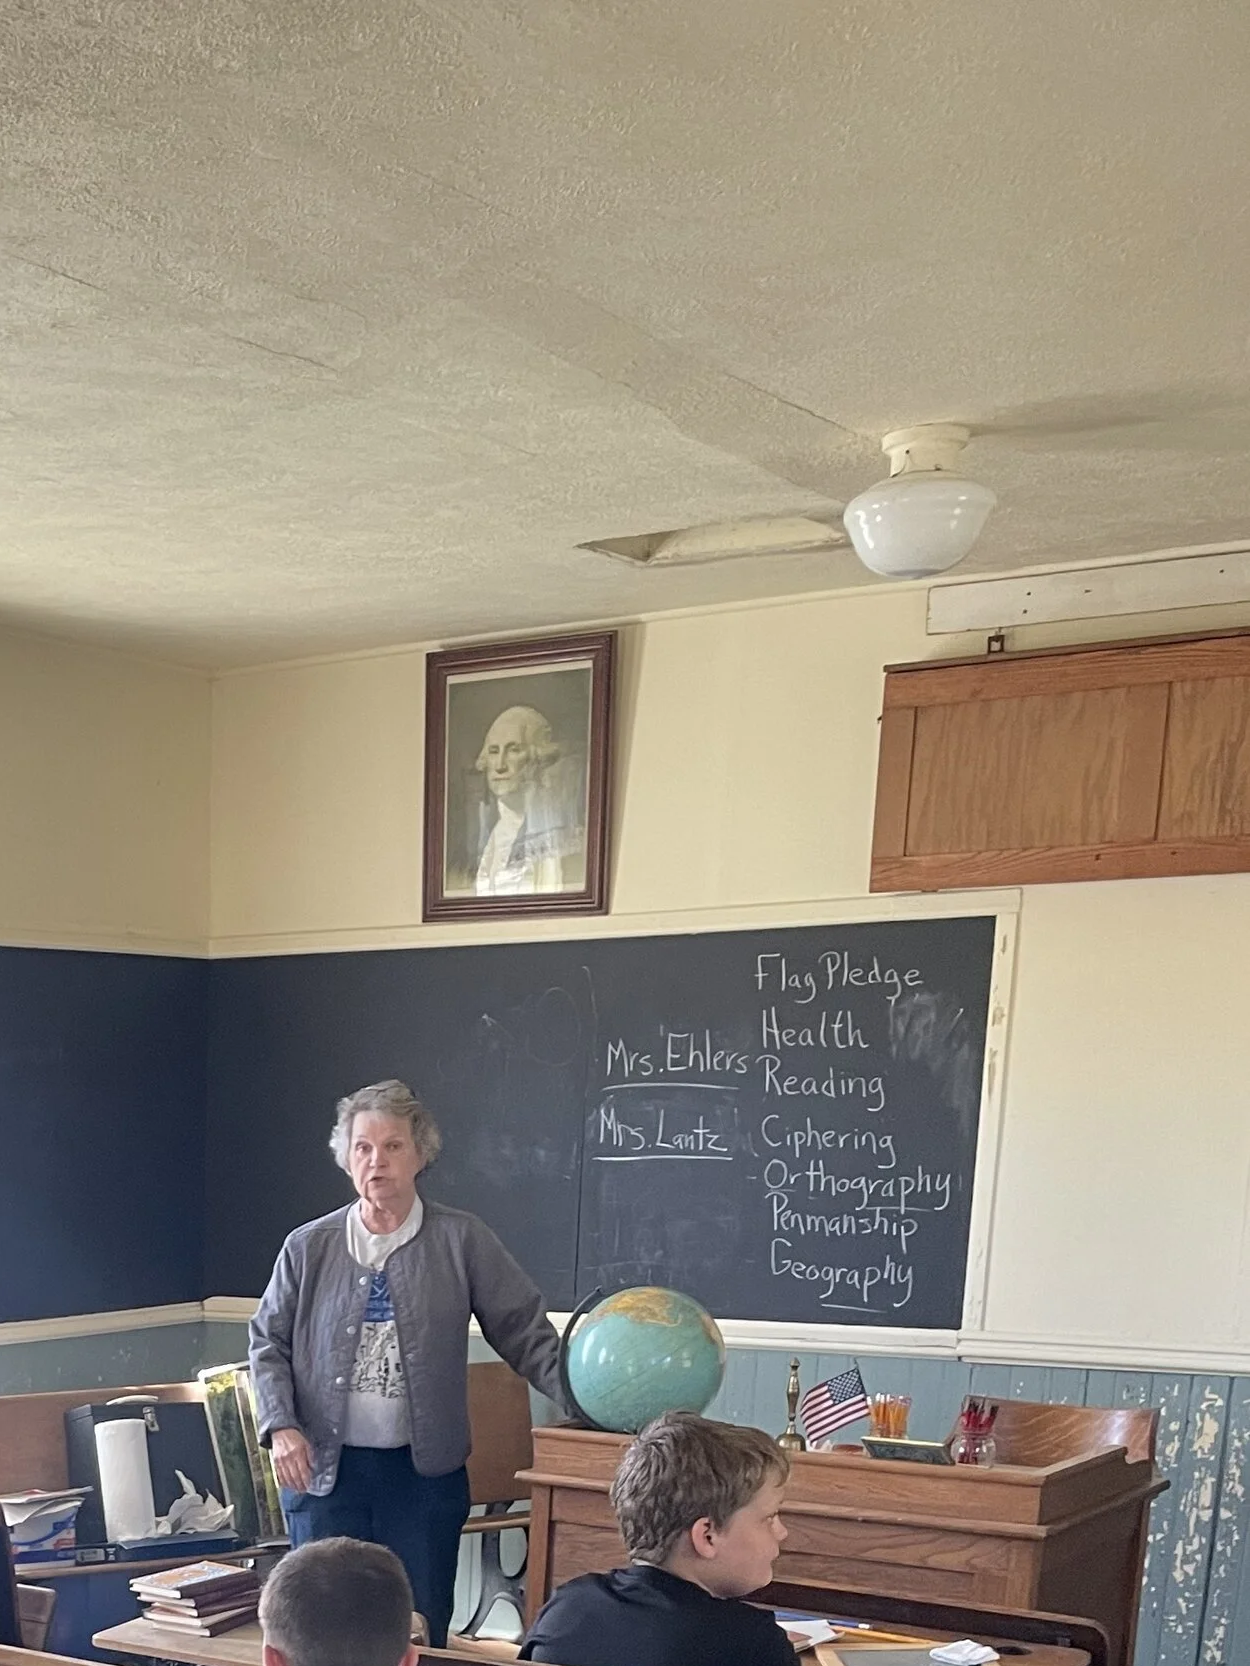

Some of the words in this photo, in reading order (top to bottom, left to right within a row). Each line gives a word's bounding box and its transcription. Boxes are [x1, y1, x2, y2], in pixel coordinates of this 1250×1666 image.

[754, 953, 818, 1004] Flag
[817, 950, 924, 1001] Pledge
[605, 1038, 665, 1078] Mrs.
[665, 1029, 749, 1075] Ehlers
[761, 1006, 870, 1050] Health
[755, 1054, 886, 1112] Reading
[598, 1105, 653, 1150] Mrs.
[656, 1109, 728, 1152] Lantz
[761, 1114, 896, 1169] Ciphering
[763, 1158, 952, 1215] Orthography
[764, 1190, 919, 1255] Penmanship
[770, 1238, 915, 1308] Geography
